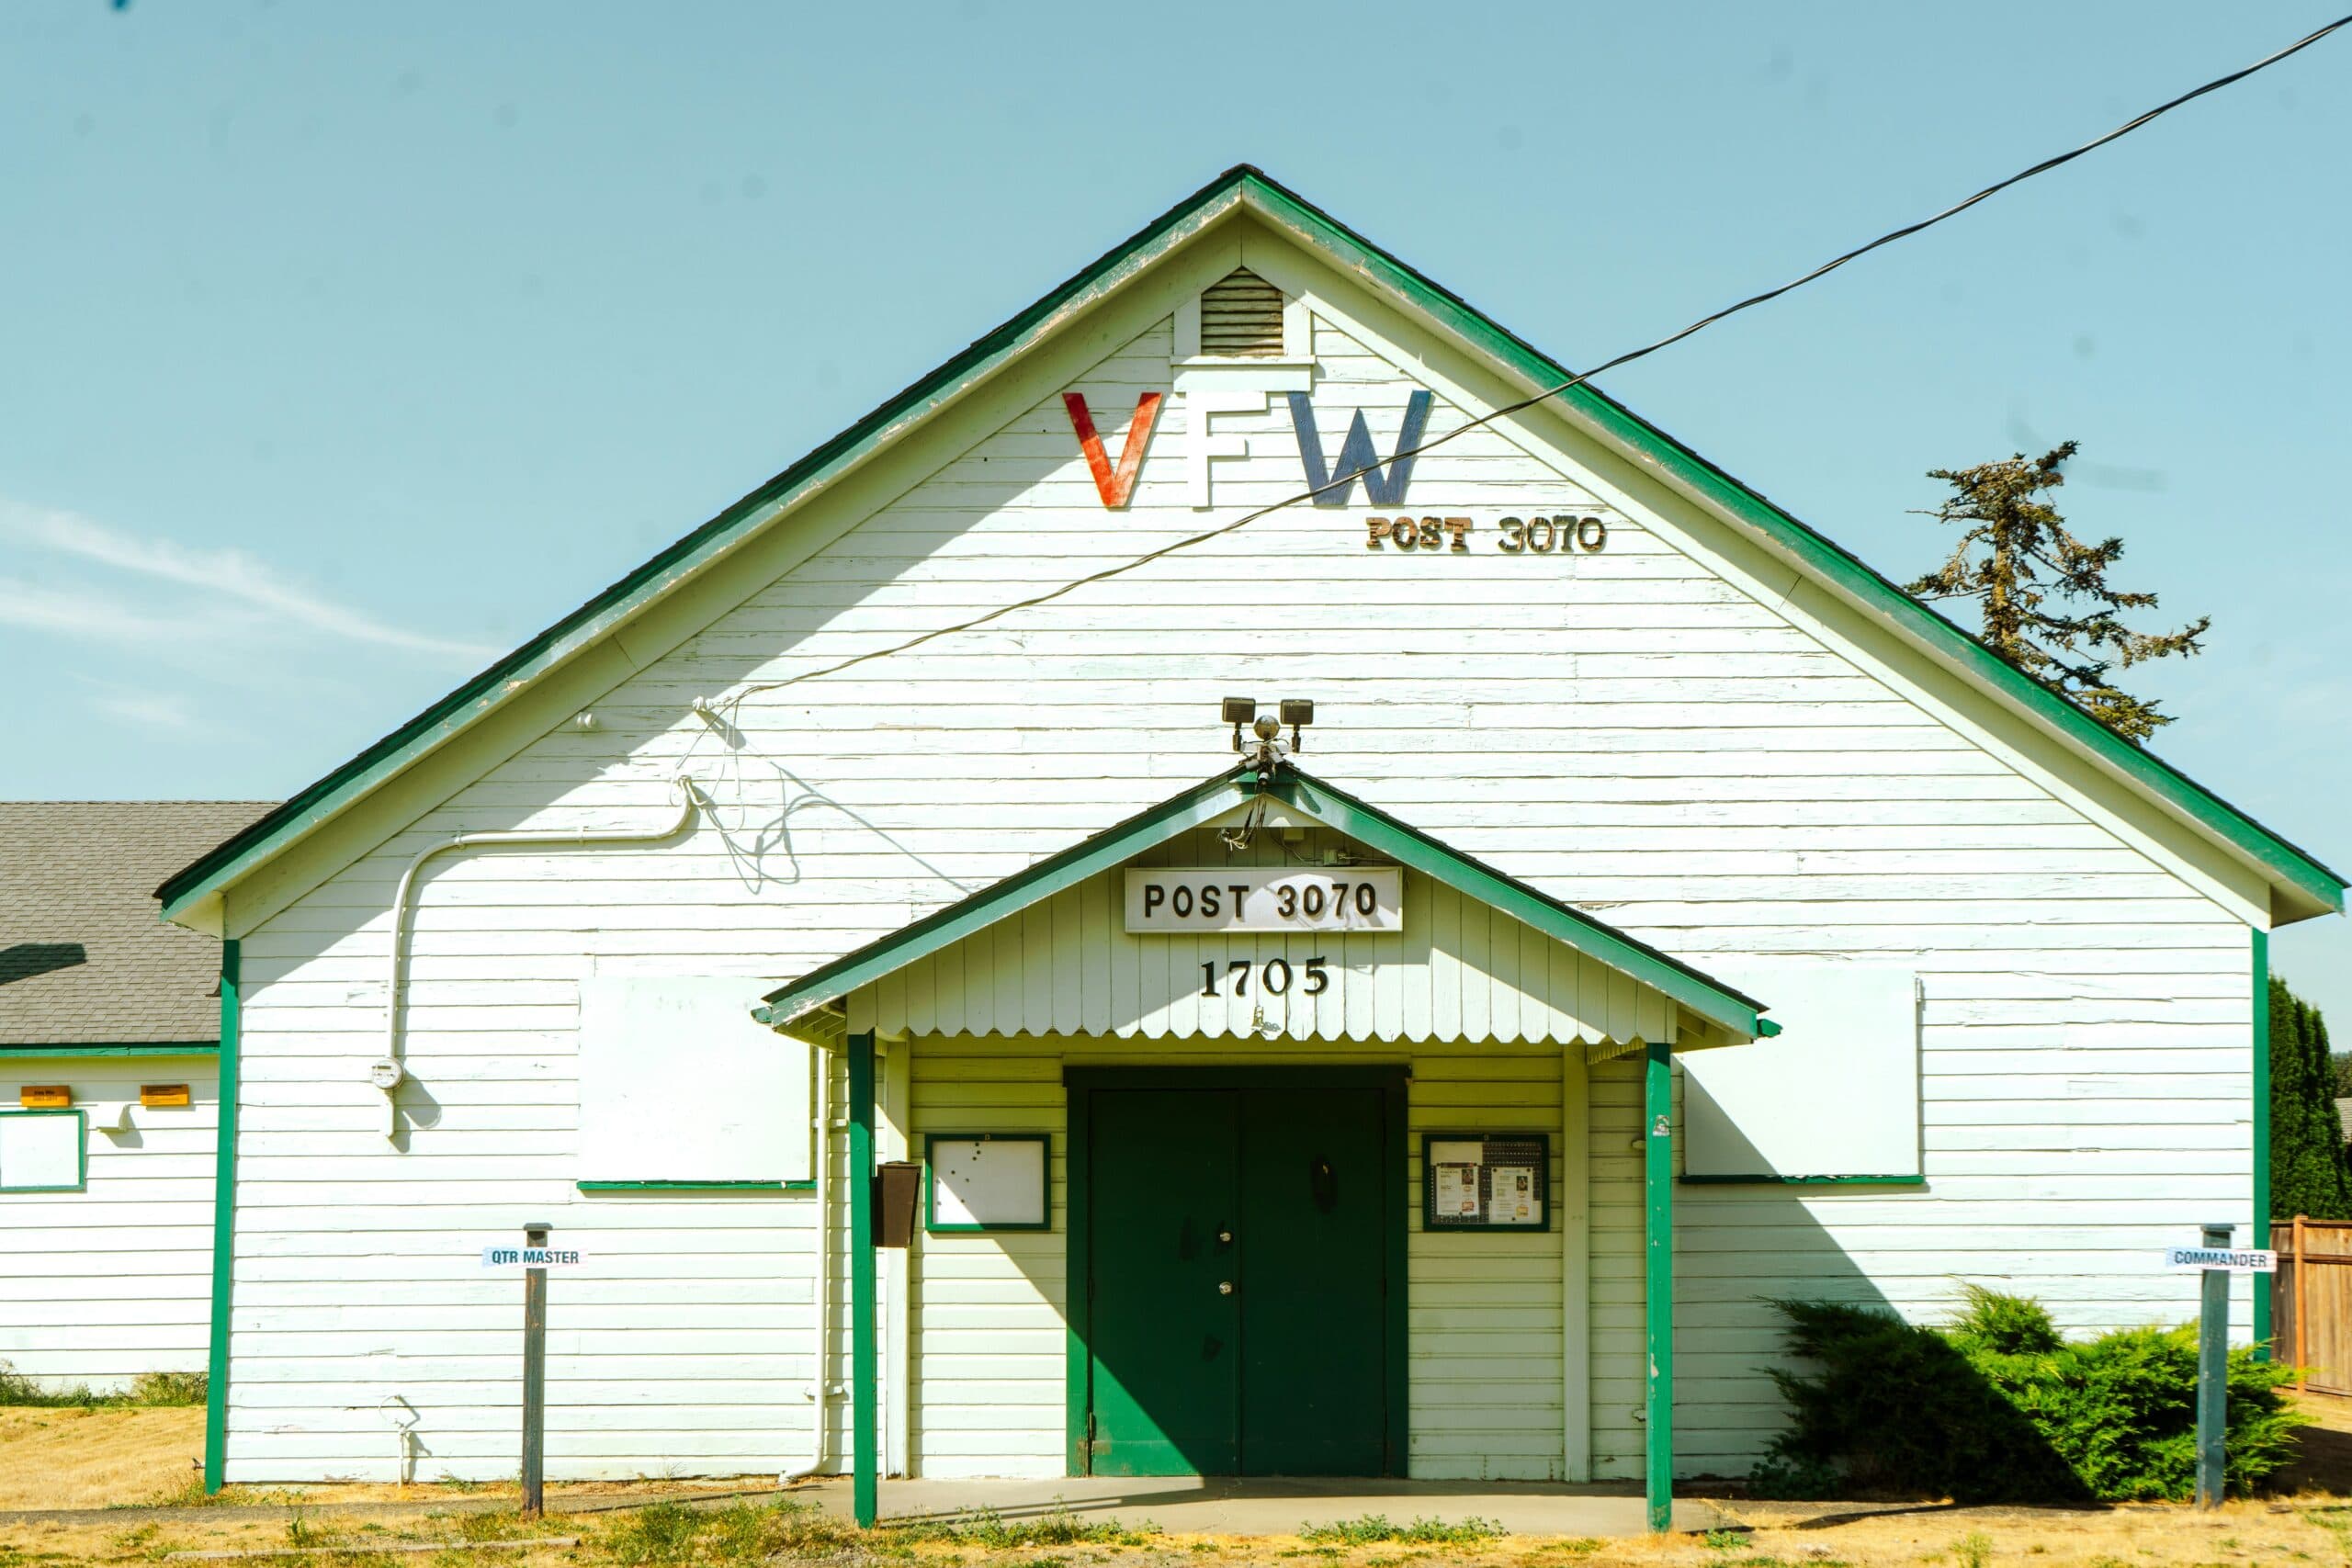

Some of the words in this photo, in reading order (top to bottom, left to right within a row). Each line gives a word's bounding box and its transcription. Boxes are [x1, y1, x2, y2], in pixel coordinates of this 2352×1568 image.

[1063, 390, 1432, 509] VFW
[1366, 516, 1471, 552] POST
[1498, 514, 1606, 552] 3070
[1144, 885, 1250, 919] POST
[1277, 883, 1376, 917] 3070
[1200, 956, 1329, 997] 1705
[492, 1250, 519, 1265] QTR
[523, 1250, 579, 1264] MASTER
[2174, 1250, 2267, 1268] COMMANDER
